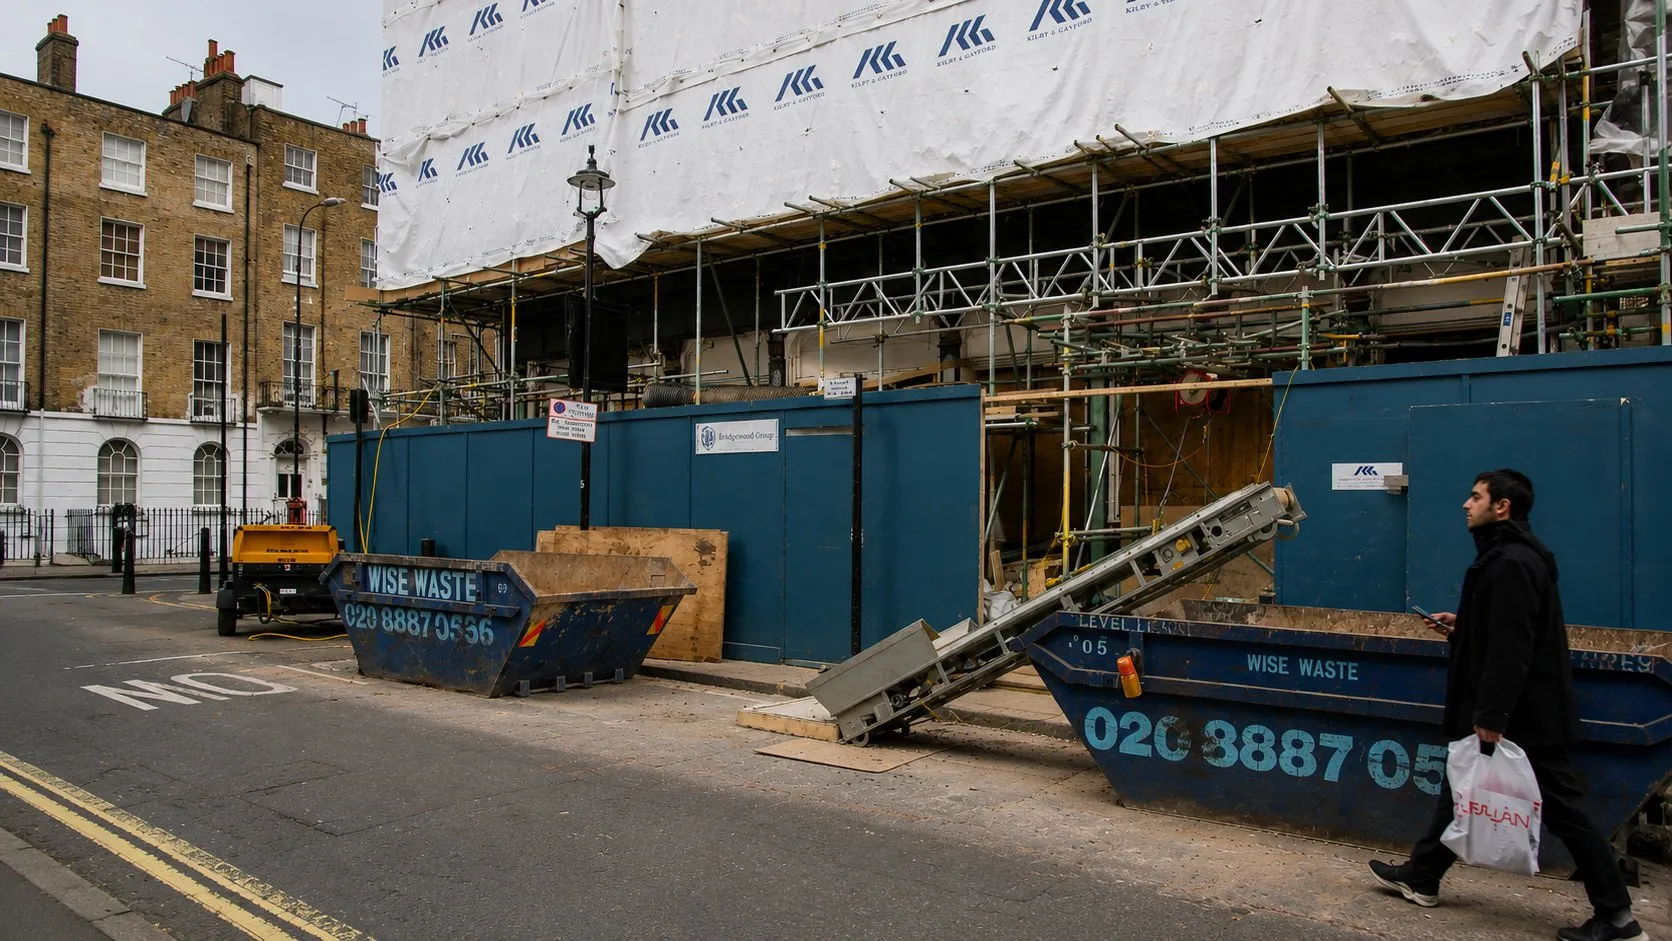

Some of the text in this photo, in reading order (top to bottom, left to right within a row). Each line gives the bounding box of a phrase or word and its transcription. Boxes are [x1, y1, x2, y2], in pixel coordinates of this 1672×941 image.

[756, 431, 775, 441] Group
[368, 564, 477, 602] WISE WASTE
[345, 602, 378, 630] 020
[381, 606, 432, 638] 8887
[1079, 614, 1130, 631] LEVEL
[1247, 654, 1359, 681] WISE WASTE
[1084, 706, 1192, 762] 020
[1201, 718, 1354, 783] 8887
